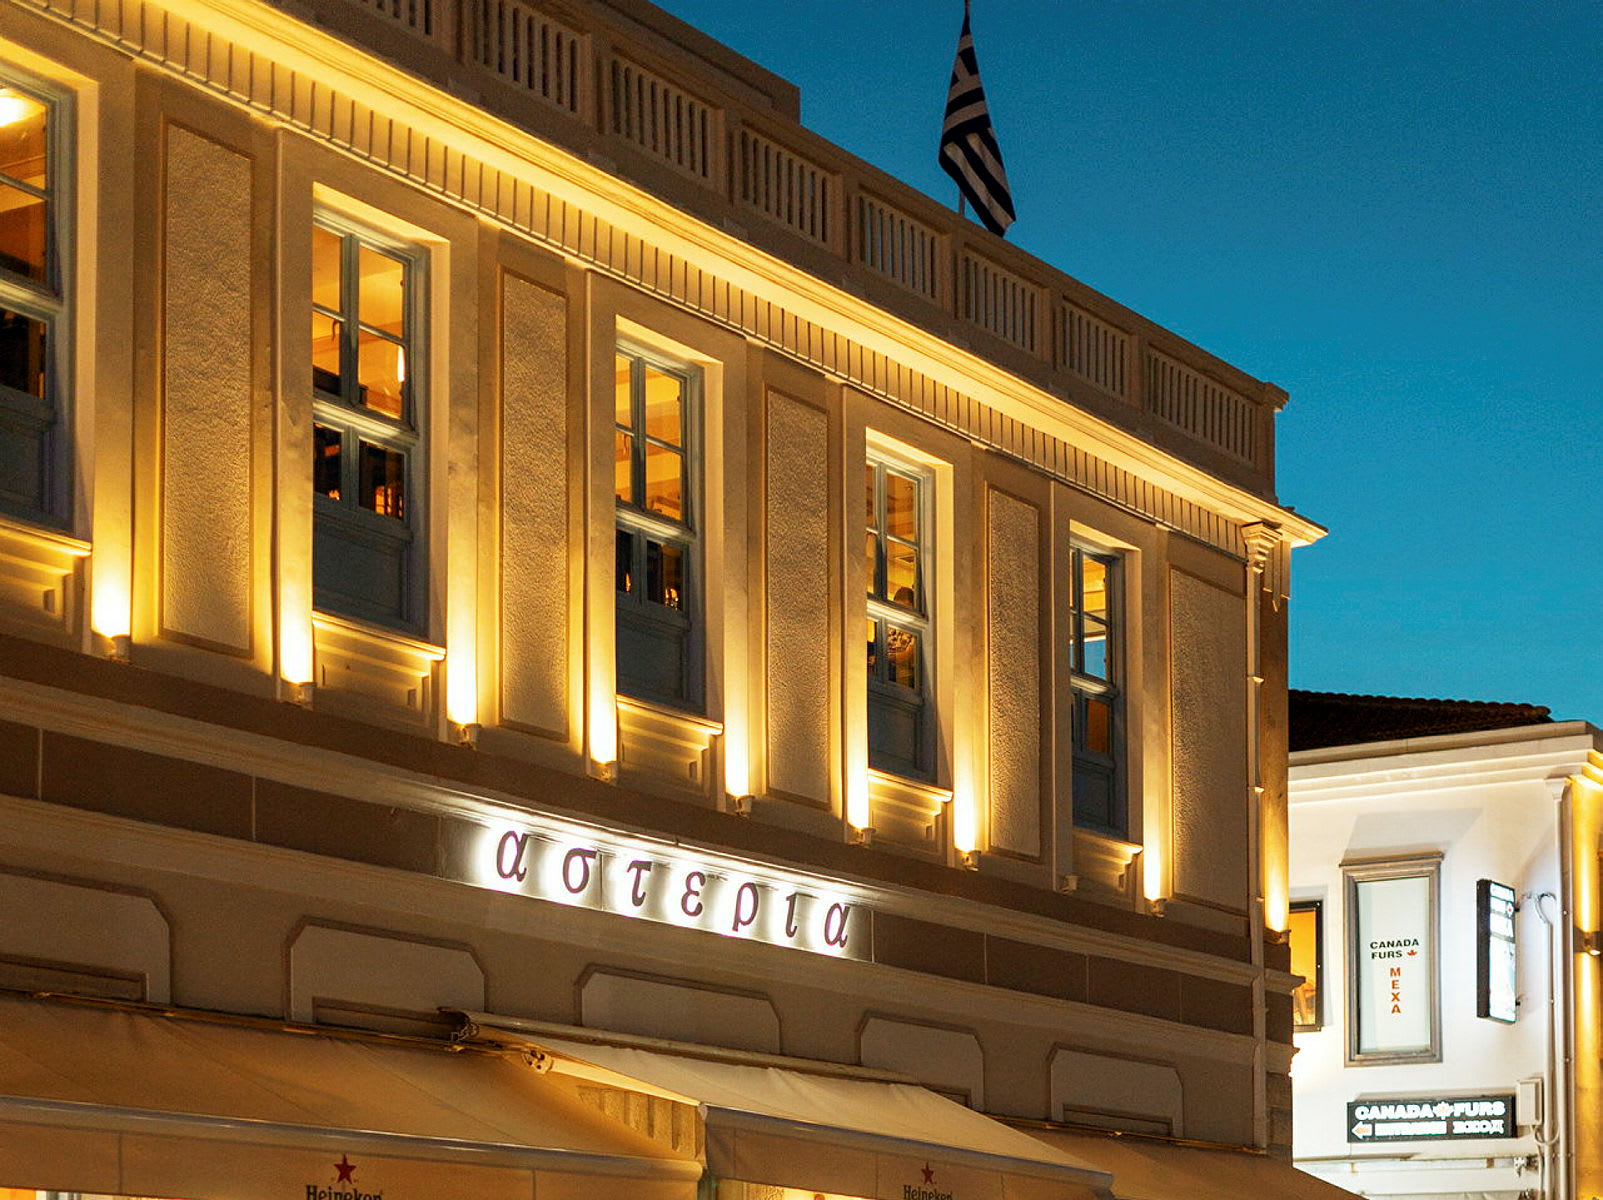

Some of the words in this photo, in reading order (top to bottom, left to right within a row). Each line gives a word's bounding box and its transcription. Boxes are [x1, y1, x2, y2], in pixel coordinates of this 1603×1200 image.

[495, 830, 851, 949] αστερια
[1369, 938, 1420, 950] CANADA
[1371, 950, 1403, 960] FURS
[1354, 1104, 1434, 1121] CANADA
[1453, 1101, 1506, 1117] FURS
